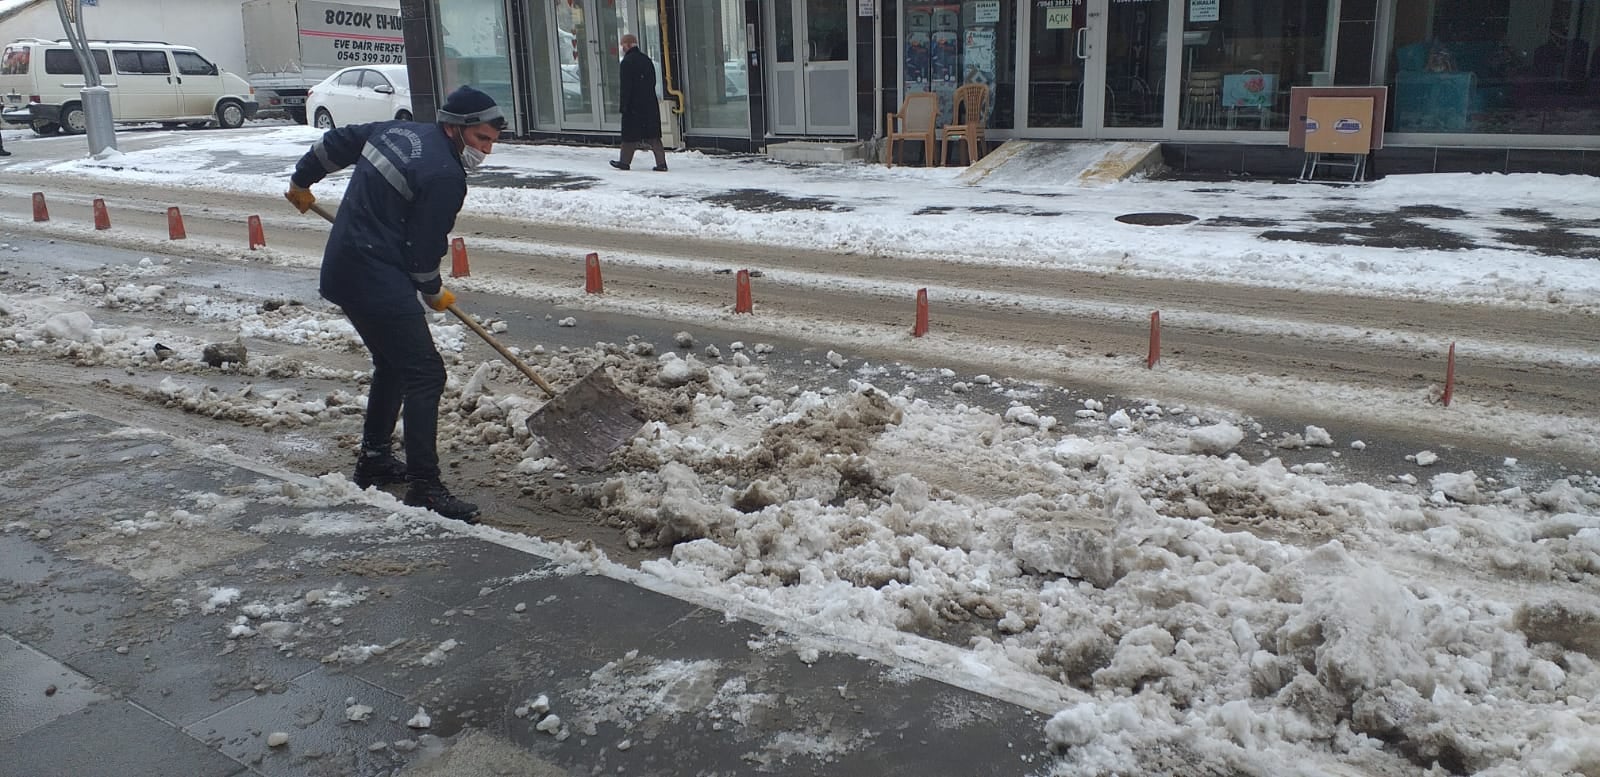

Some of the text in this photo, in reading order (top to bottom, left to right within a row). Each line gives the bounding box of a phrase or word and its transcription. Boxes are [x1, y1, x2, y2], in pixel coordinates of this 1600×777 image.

[325, 9, 372, 28] BOZOK
[1049, 13, 1069, 24] AÇIK
[334, 39, 404, 54] EVE DAİR HERŞEY
[337, 51, 403, 64] 0545 399 30 70
